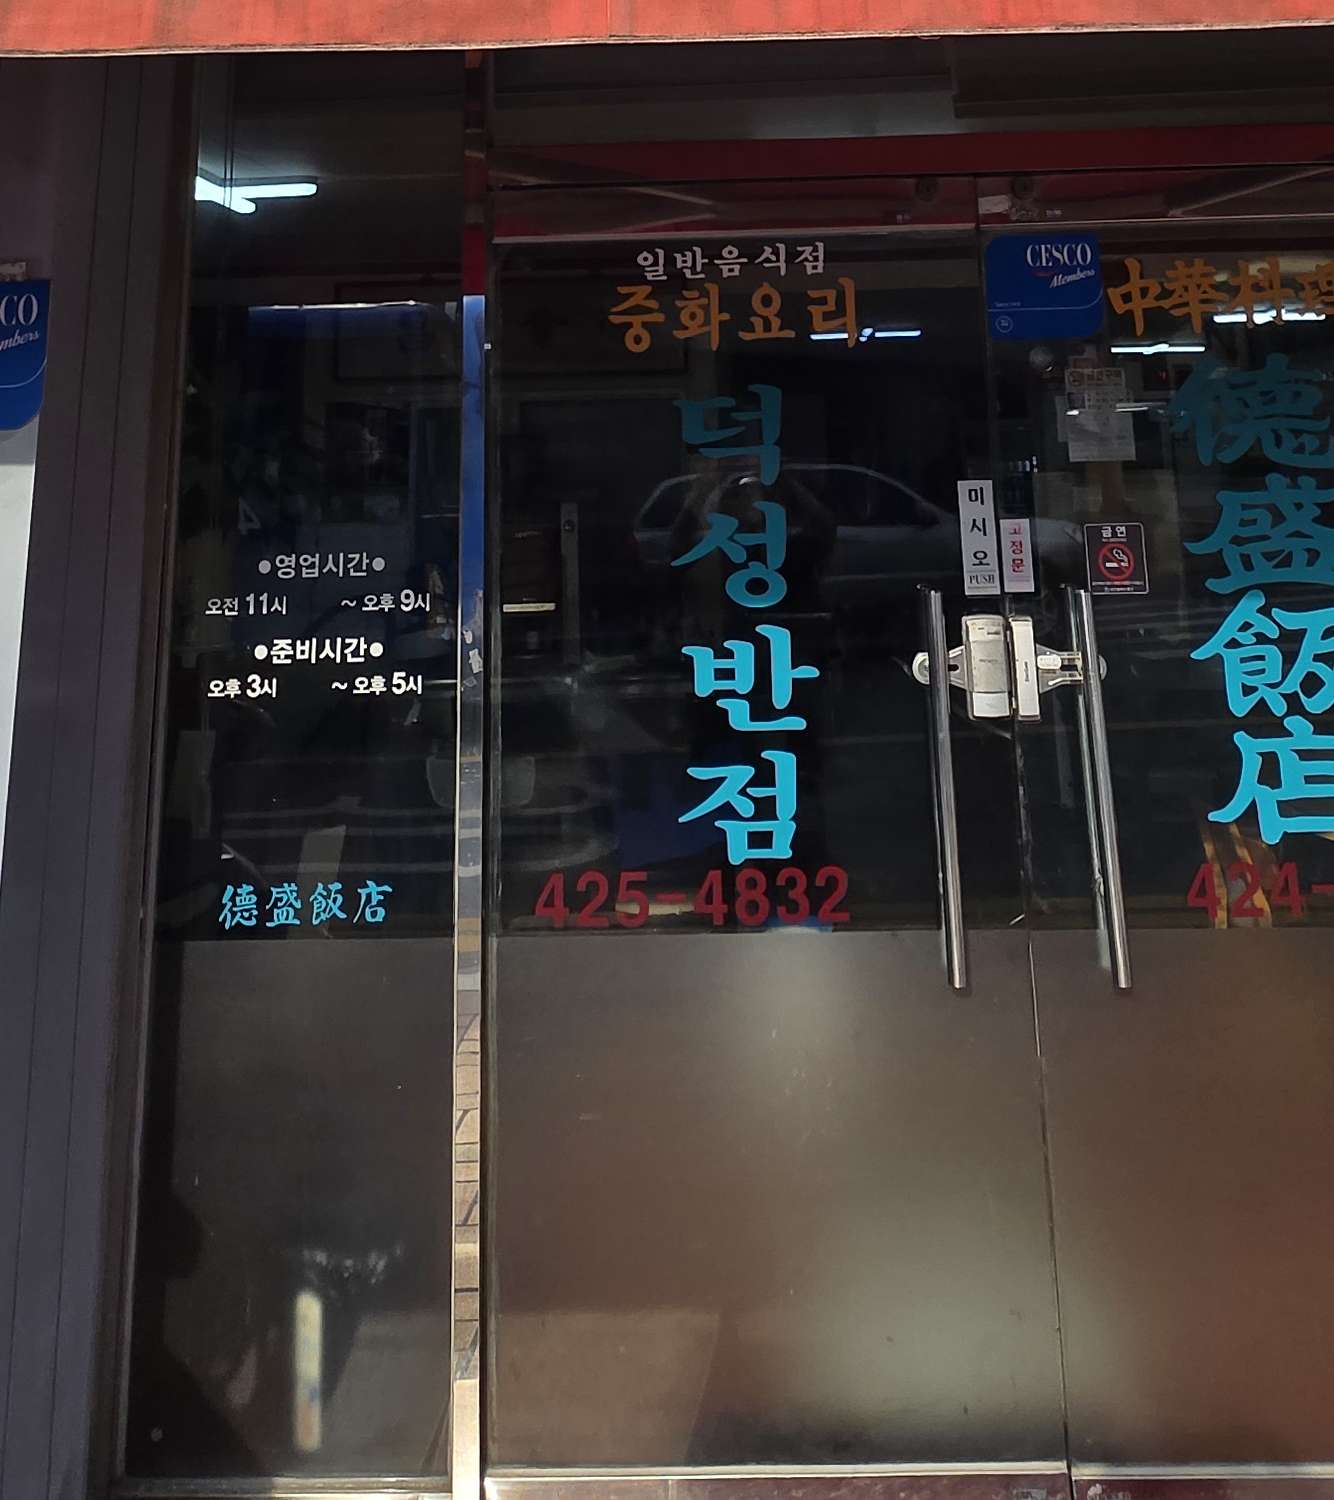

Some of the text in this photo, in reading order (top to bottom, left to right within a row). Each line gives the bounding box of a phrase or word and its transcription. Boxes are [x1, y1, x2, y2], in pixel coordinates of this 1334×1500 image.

[637, 241, 825, 281] 일반음식점
[1026, 243, 1092, 268] CESCO
[1049, 268, 1095, 289] Members
[607, 276, 858, 353] 중화요리
[967, 486, 991, 567] 미시오
[1008, 522, 1026, 573] 고정문
[274, 552, 370, 579] 영업시간
[969, 574, 995, 586] PUSH
[205, 597, 239, 616] 오전
[245, 592, 288, 616] 11시
[362, 593, 396, 613] 오후
[400, 589, 431, 613] 9시
[670, 383, 821, 865] 덕성반점
[270, 637, 367, 665] 준비시간
[207, 678, 242, 699] 오후
[246, 674, 278, 698] 3시
[353, 675, 387, 696] 오후
[391, 671, 423, 696] 5시
[218, 879, 394, 931] 德盛飯店
[534, 865, 851, 928] 425-4832
